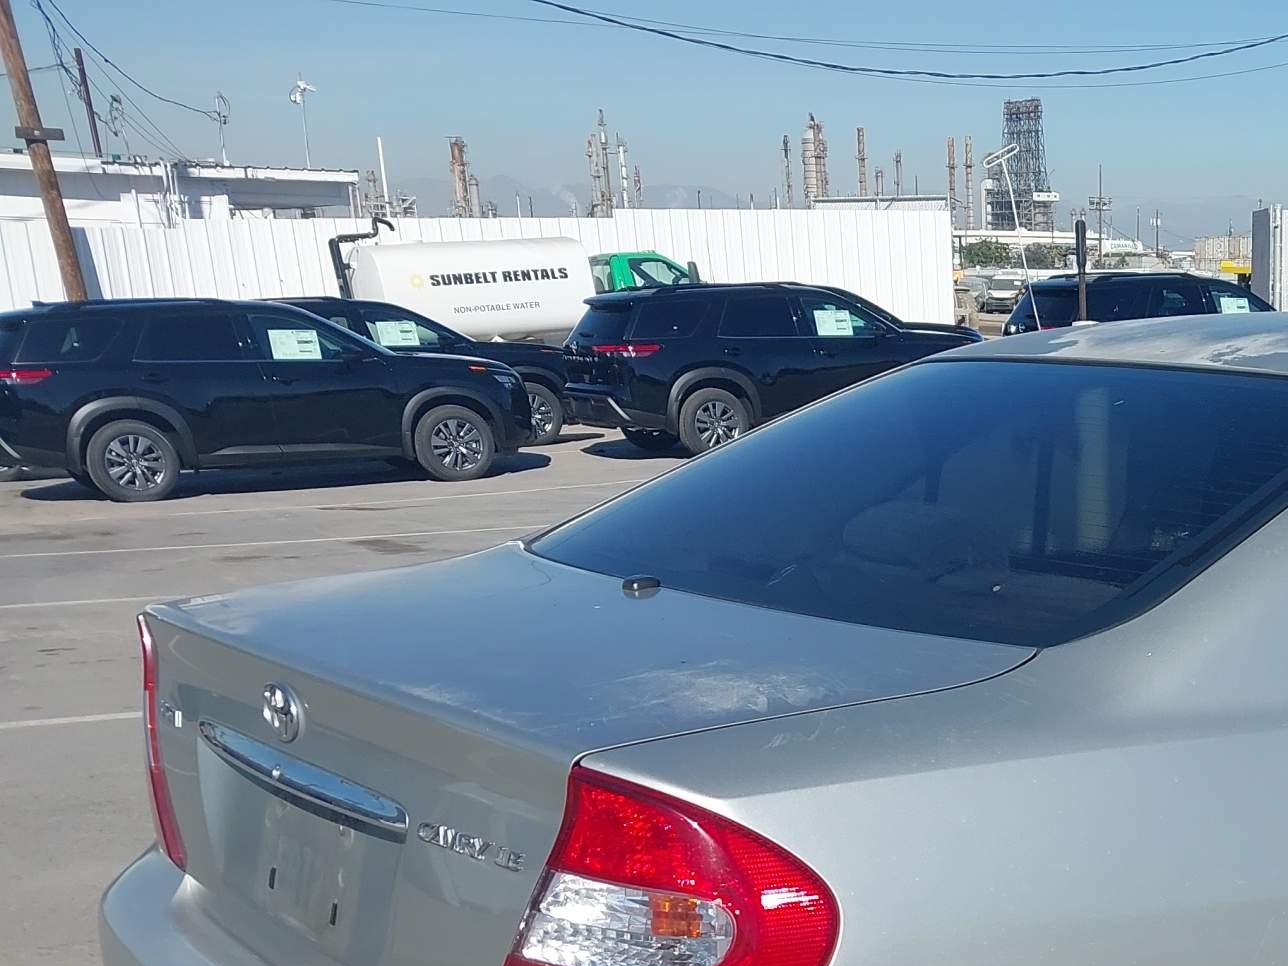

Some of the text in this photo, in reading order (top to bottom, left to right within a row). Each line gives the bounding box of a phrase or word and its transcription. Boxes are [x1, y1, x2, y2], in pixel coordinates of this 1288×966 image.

[430, 267, 569, 286] SUNBELT RENTALS
[454, 301, 540, 314] NON-POTABLE WATER
